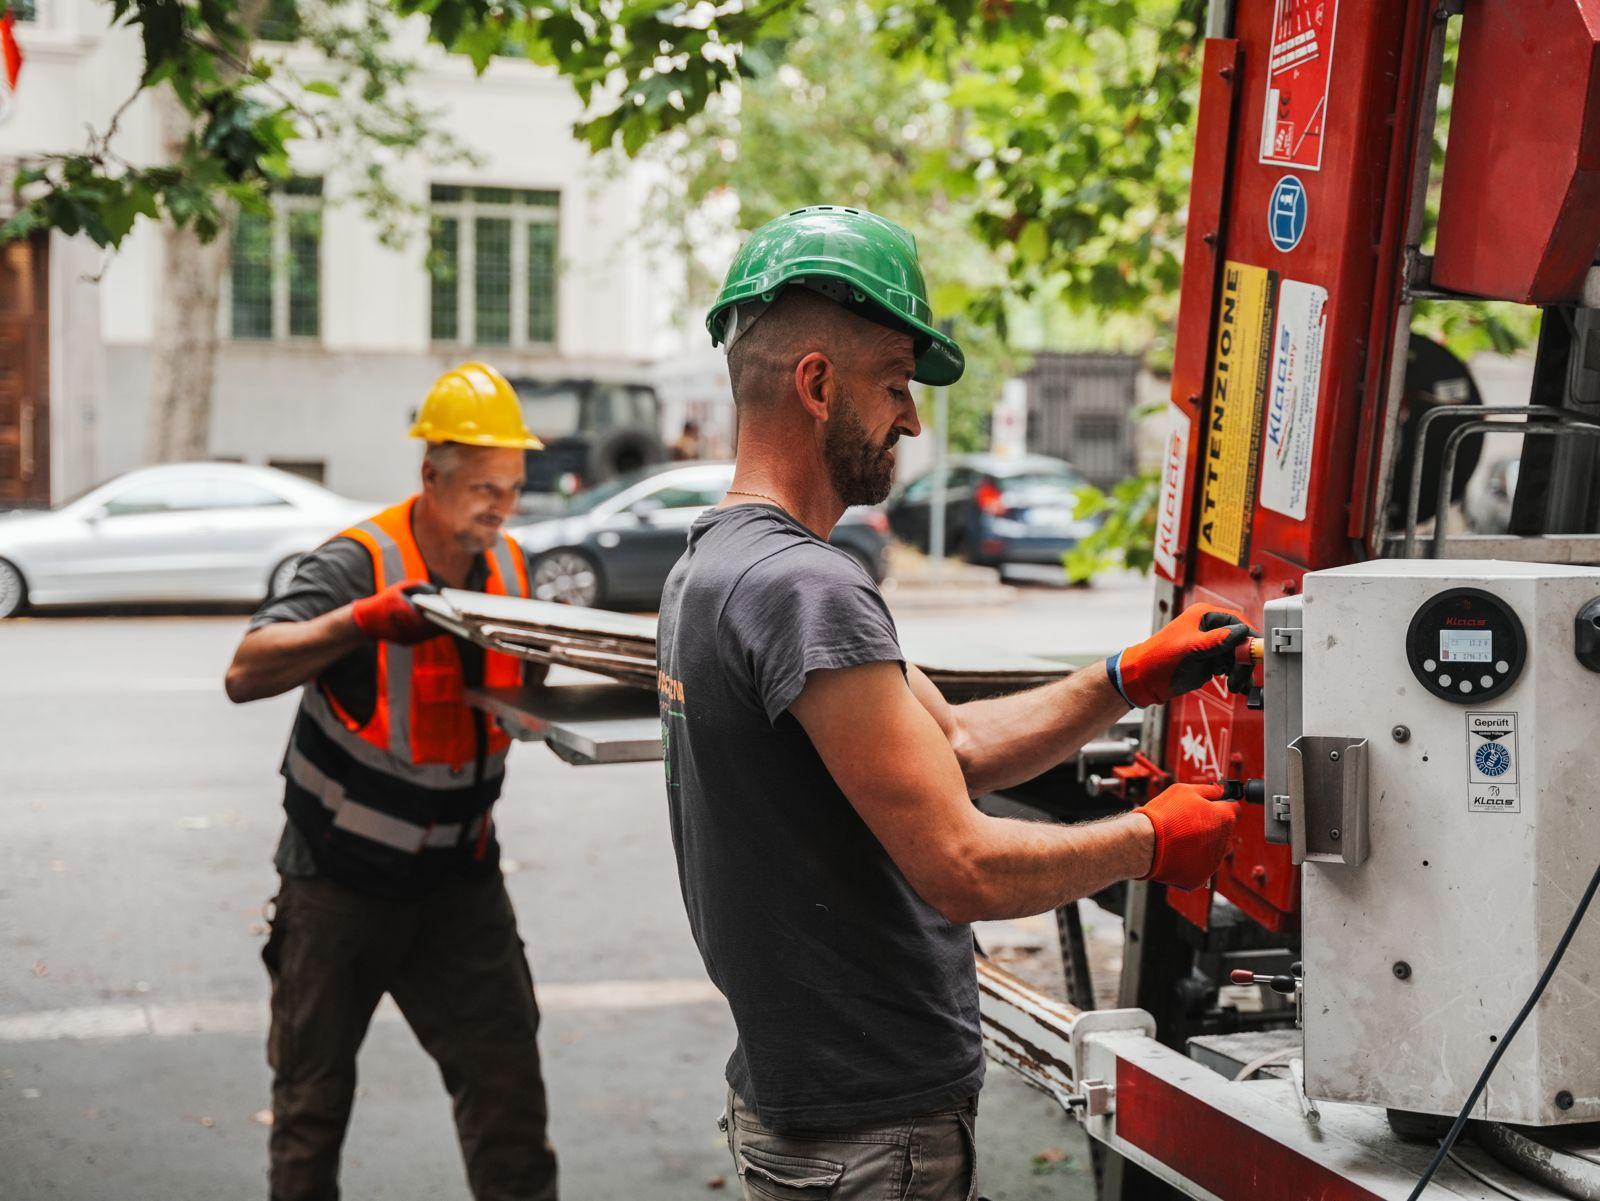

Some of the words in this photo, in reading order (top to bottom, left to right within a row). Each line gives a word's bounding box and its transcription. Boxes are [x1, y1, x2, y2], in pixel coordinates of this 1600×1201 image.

[1287, 343, 1297, 383] Italy
[1202, 268, 1239, 545] ATTENZIONE
[1474, 718, 1509, 728] Geprüft
